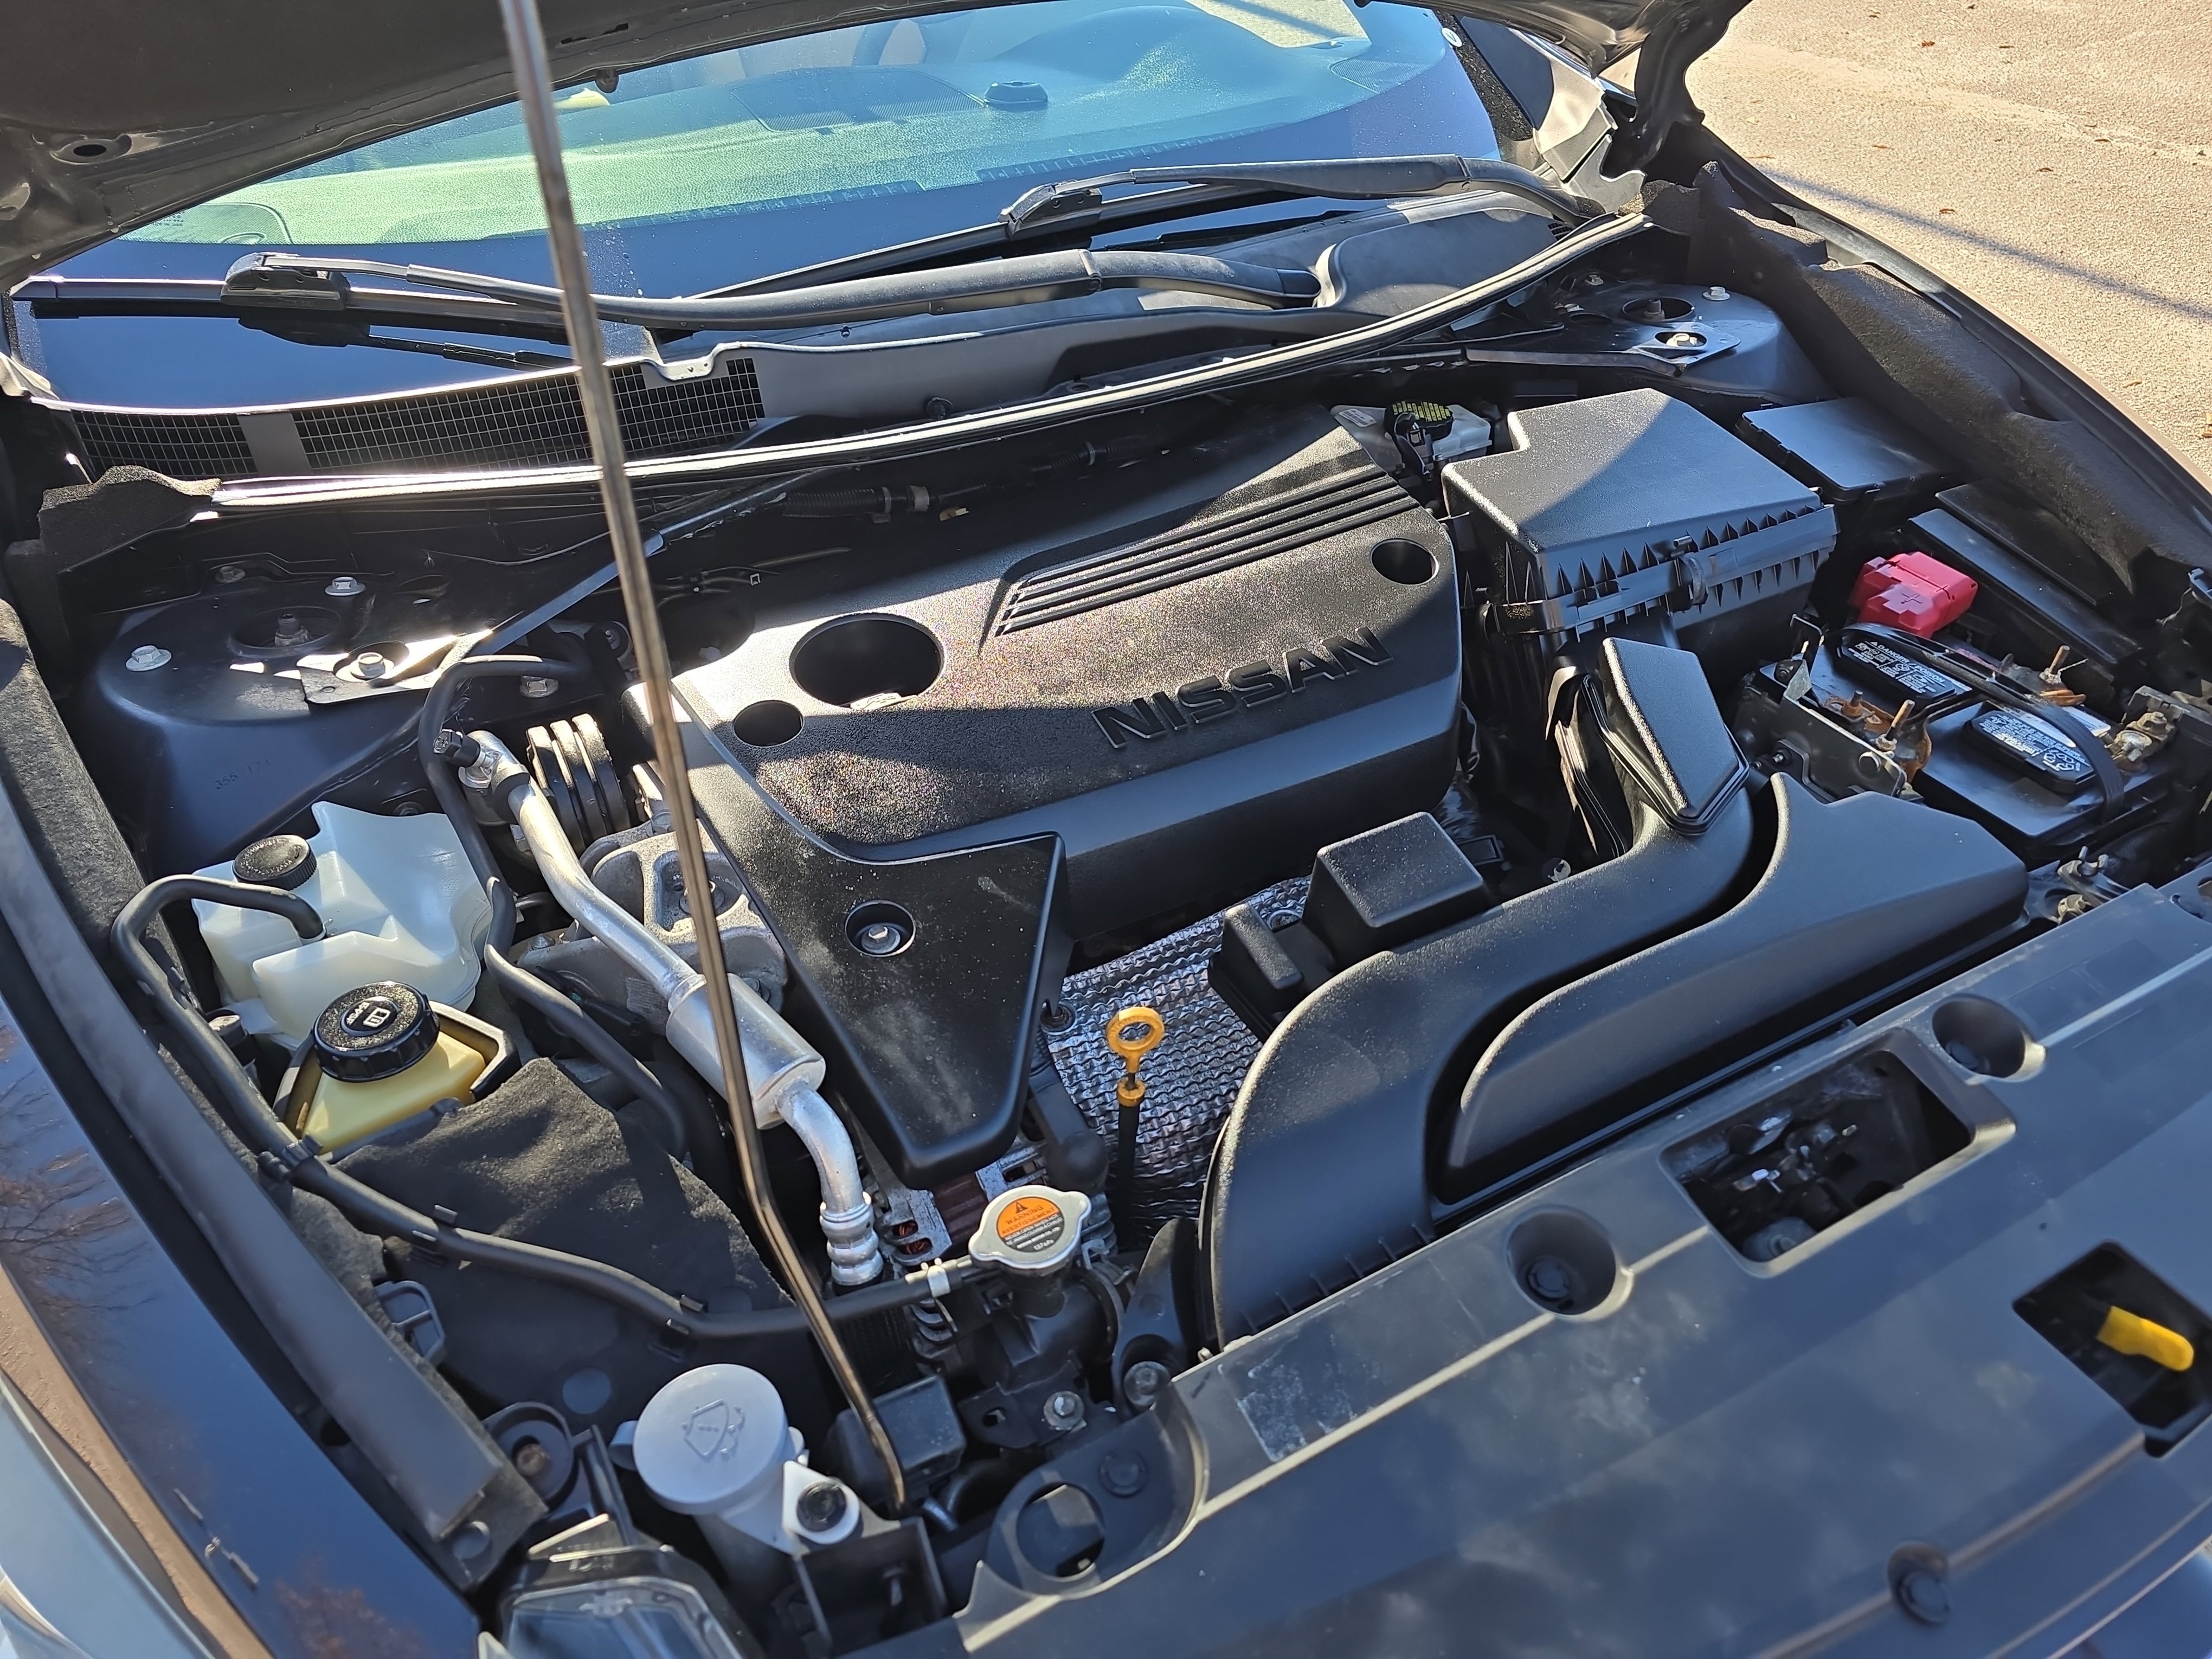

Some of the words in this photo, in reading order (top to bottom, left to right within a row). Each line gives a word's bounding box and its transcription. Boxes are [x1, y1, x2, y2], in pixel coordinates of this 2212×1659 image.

[1877, 644, 1909, 664] DANGER
[1915, 665, 1946, 684] POISON
[1090, 626, 1393, 748] NISSAN
[1002, 1207, 1054, 1234] AVERTISSEMENT
[1006, 1205, 1044, 1224] WARNING
